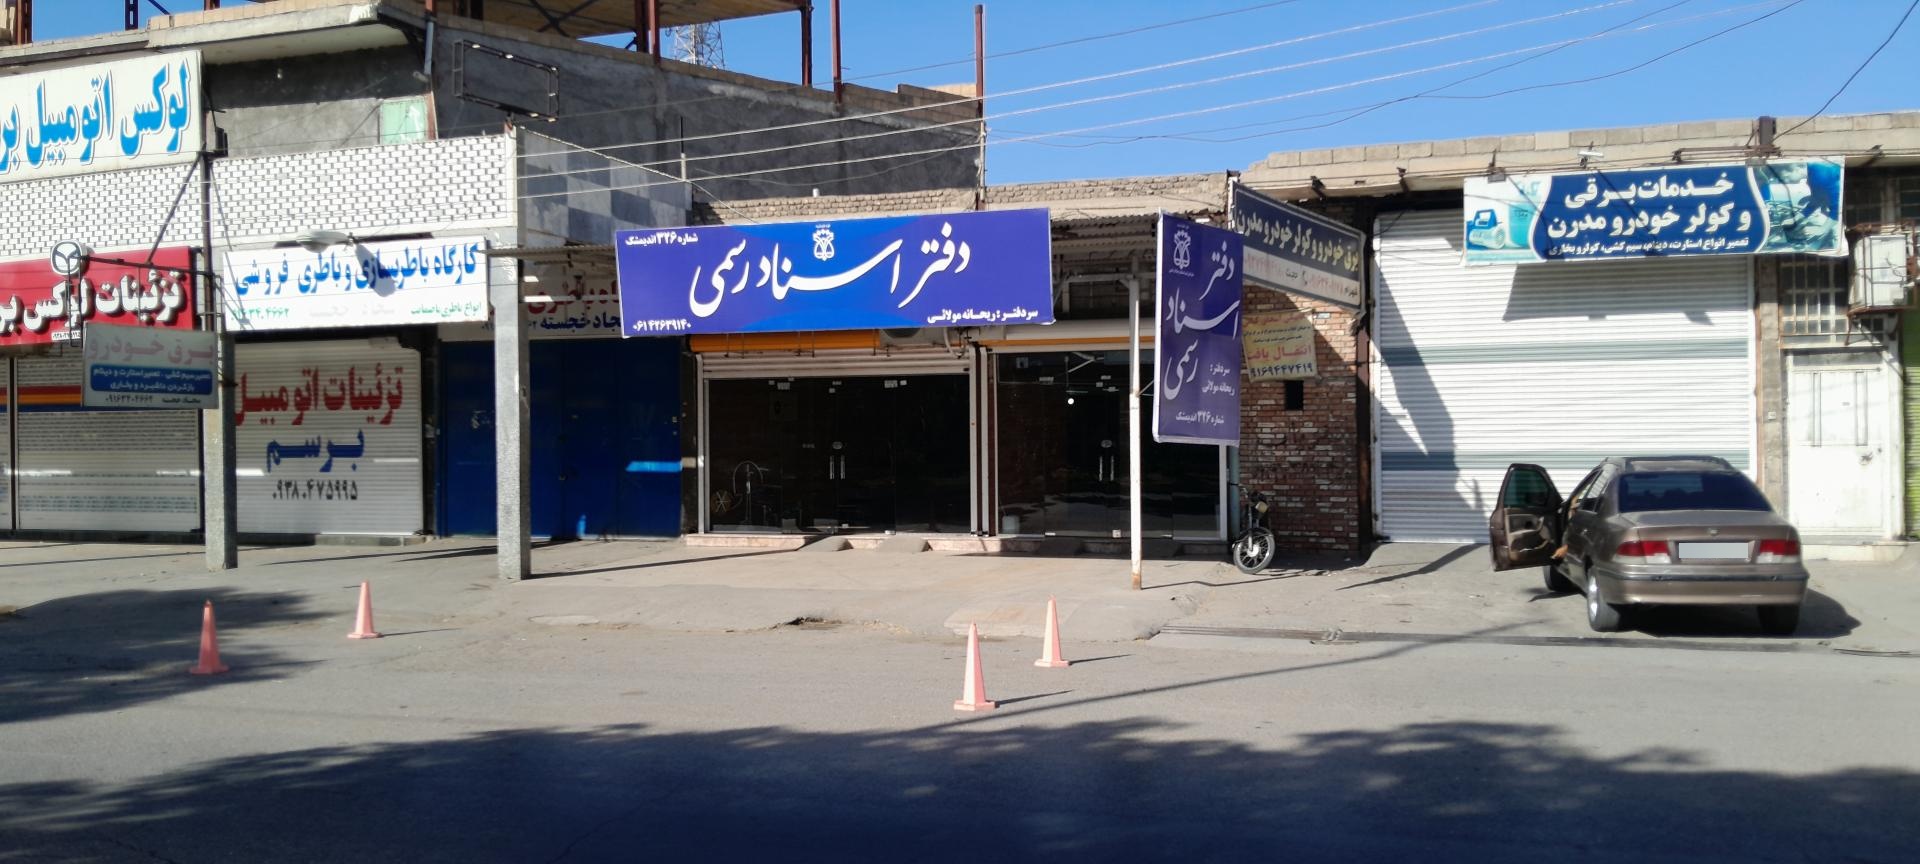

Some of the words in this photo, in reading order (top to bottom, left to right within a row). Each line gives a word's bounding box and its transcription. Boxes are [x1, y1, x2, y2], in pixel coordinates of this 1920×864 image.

[26, 70, 113, 167] اتومبیل
[119, 60, 191, 157] لوکس
[0, 105, 20, 172] بر
[1564, 178, 1637, 209] برقی
[1638, 171, 1735, 199] خدمات
[1236, 209, 1263, 237] مدرن
[1263, 219, 1293, 249] خودرو
[1547, 212, 1608, 239] مدرن
[1610, 204, 1681, 237] خودرو
[1683, 201, 1736, 234] کولر
[1736, 209, 1752, 232] و
[625, 234, 656, 248] اندیمشک
[656, 231, 677, 245] ۳۲۶
[678, 233, 699, 247] شماره
[1291, 223, 1313, 257] کولر
[1702, 236, 1726, 250] انواع
[1725, 236, 1750, 250] تعمیر
[298, 251, 342, 294] باطری
[433, 241, 479, 285] کارگاه
[689, 239, 750, 318] رسمی
[756, 238, 904, 300] اسناد
[898, 221, 971, 309] دفتر
[1199, 240, 1235, 301] دفتر
[95, 268, 186, 325] تزئینات
[0, 294, 24, 334] بر
[540, 312, 591, 333] خجسته
[593, 311, 622, 333] جاد
[962, 308, 996, 323] ریحانه
[1165, 287, 1241, 341] اسناد
[86, 334, 166, 363] خودرو
[167, 336, 214, 366] برق
[1164, 339, 1198, 400] رسمی
[235, 364, 320, 427] اتومبیل
[323, 362, 404, 426] تزئینات
[266, 428, 366, 474] برسم
